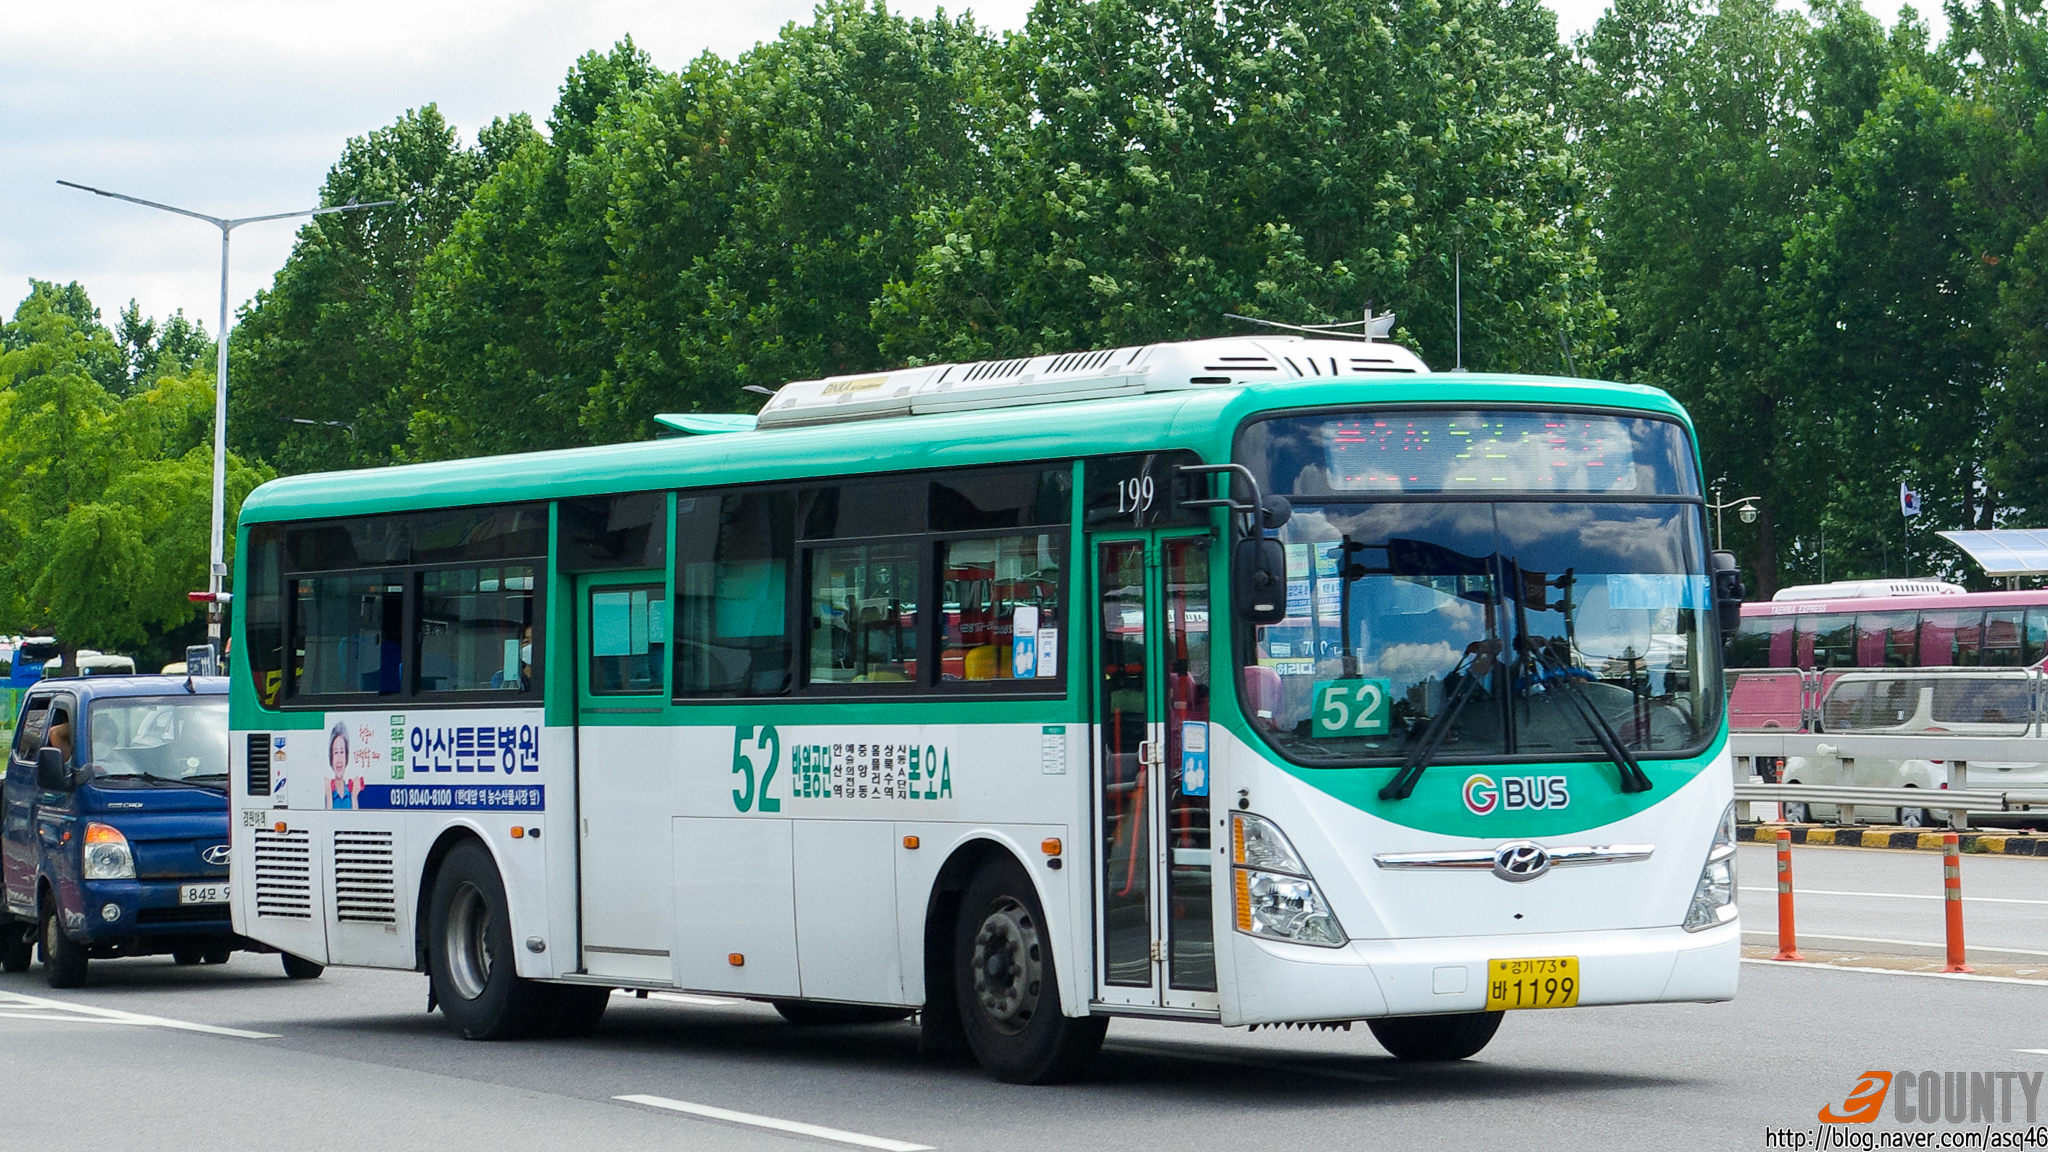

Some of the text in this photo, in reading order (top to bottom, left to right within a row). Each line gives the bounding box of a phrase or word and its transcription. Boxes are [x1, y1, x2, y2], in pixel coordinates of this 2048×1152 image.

[1117, 475, 1154, 513] 199
[1798, 604, 1828, 613] EXPRESS
[1321, 684, 1382, 731] 52
[410, 724, 539, 775] 안산튼튼병원
[731, 724, 781, 813] 52
[791, 744, 832, 799] 반월공단
[833, 744, 843, 798] 안산역
[845, 744, 855, 799] 예술의전당
[857, 744, 868, 799] 중앙동
[871, 744, 881, 800] 홈플러스
[883, 744, 894, 800] 상록수역
[909, 744, 953, 800] 본오A
[488, 788, 528, 806] 농수산물시장
[189, 888, 216, 903] 84모
